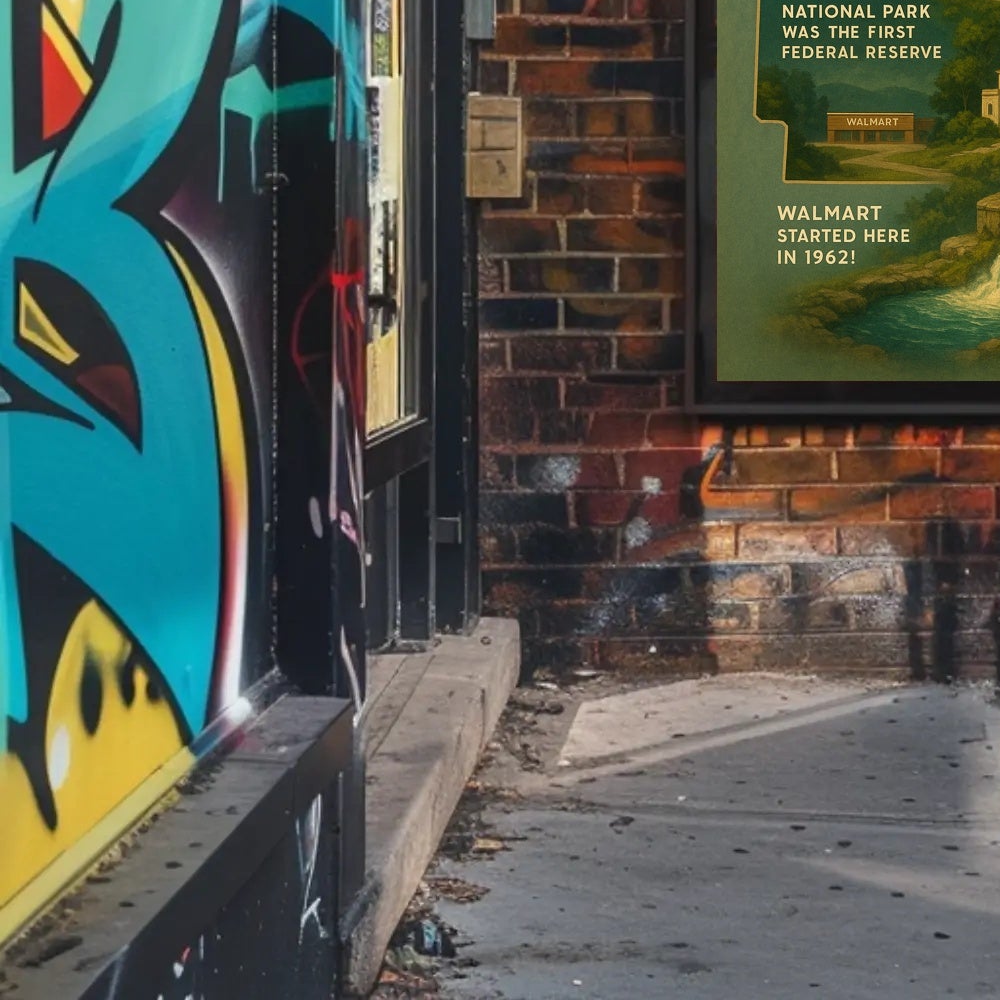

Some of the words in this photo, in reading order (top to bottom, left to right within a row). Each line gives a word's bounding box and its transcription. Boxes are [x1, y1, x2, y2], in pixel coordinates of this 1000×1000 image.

[782, 4, 876, 19] NATIONAL
[883, 4, 931, 19] PARK
[782, 25, 820, 39] WAS
[828, 25, 860, 39] THE
[868, 25, 916, 39] FIRST
[782, 45, 859, 59] FEDERAL
[866, 45, 942, 59] RESERVE
[846, 117, 899, 126] WALMART
[777, 205, 882, 221] WALMART
[777, 228, 856, 243] STARTED
[864, 228, 910, 243] HERE
[777, 249, 796, 265] IN
[804, 249, 855, 265] 1962!
